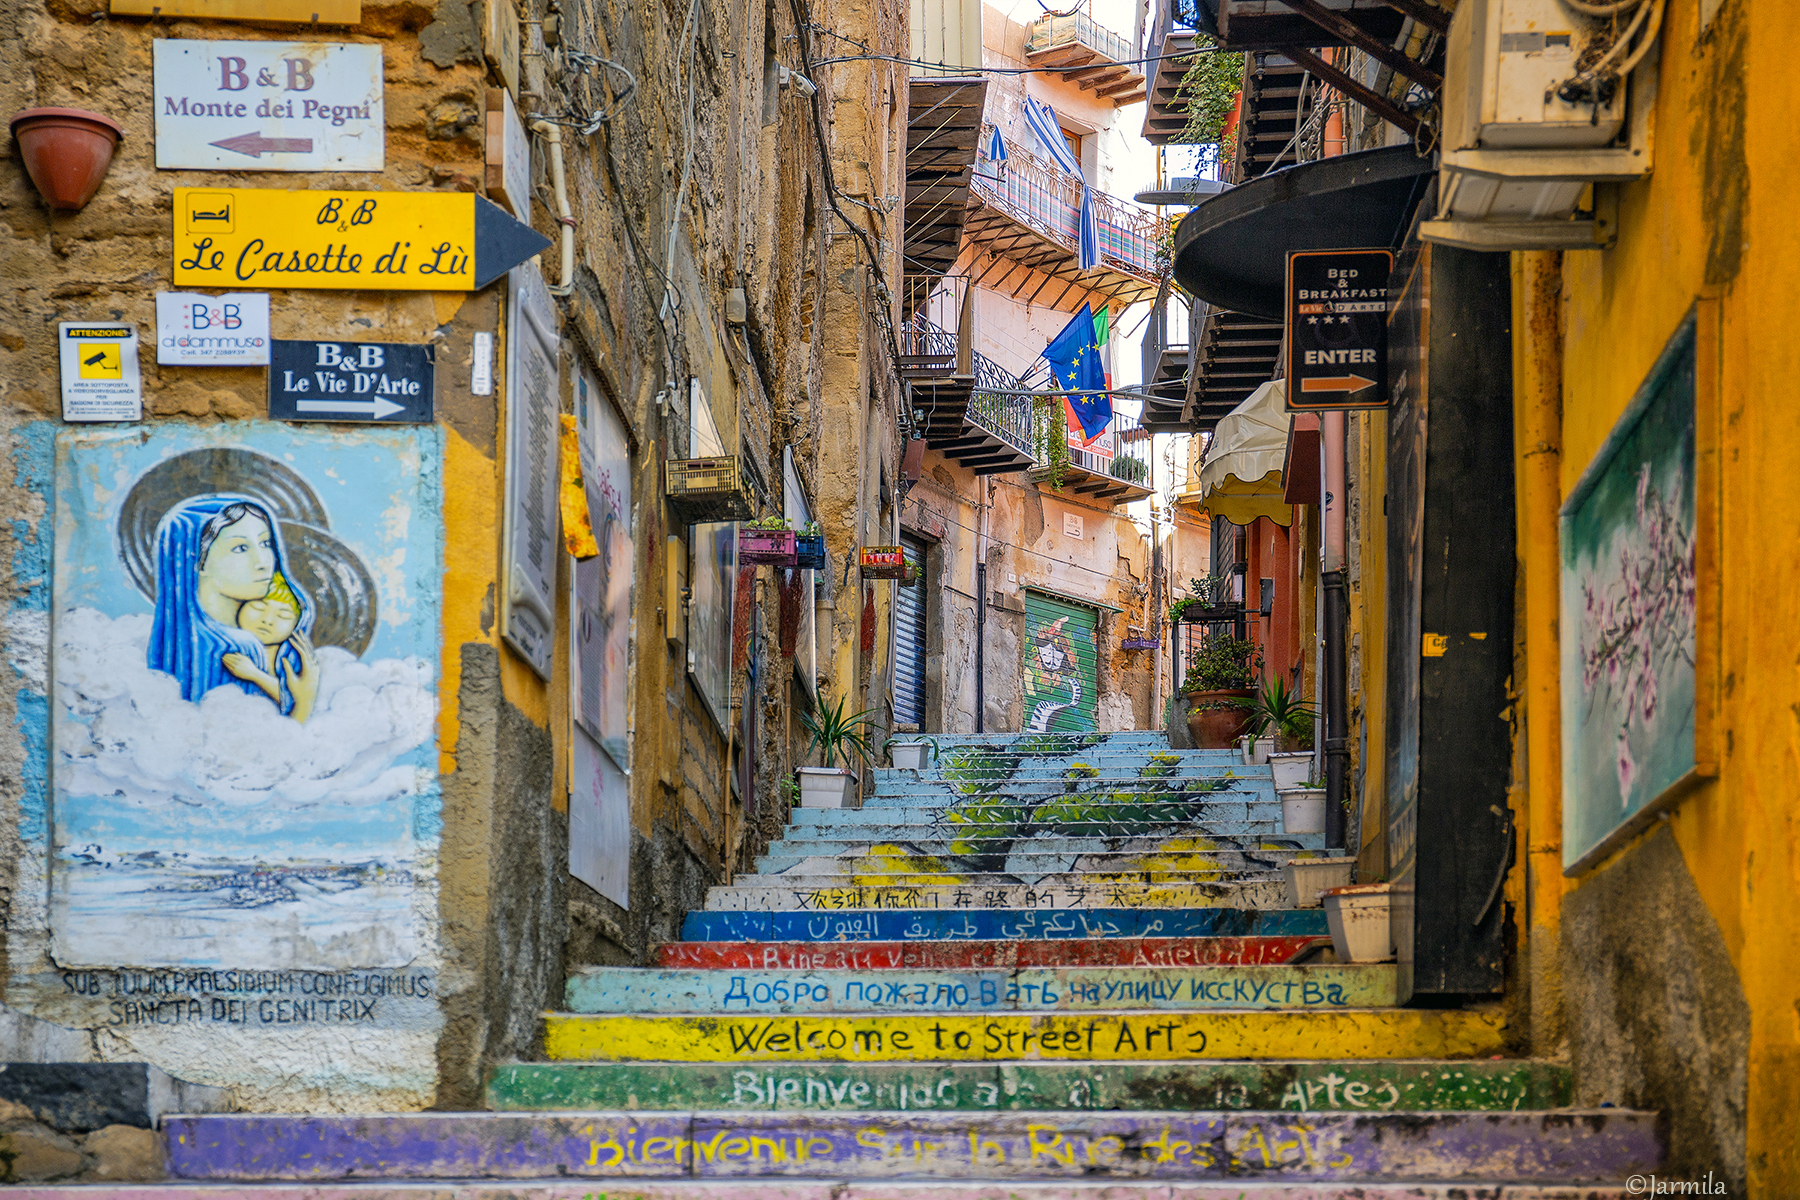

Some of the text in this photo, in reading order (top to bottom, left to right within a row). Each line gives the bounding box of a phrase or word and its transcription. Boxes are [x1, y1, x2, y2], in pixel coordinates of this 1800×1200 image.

[164, 96, 372, 126] Monte dei Pegni
[180, 237, 469, 281] Le Casette di Lù
[1338, 278, 1348, 288] &
[1304, 349, 1377, 365] ENTER
[283, 370, 421, 395] Le Vie D'Arte
[62, 971, 100, 996] SUB
[301, 972, 430, 998] CONFUGIMUS
[108, 998, 378, 1026] SANCTA DEI GENITRIX
[729, 1020, 914, 1054] Welcome
[928, 1021, 972, 1051] to
[983, 1022, 1101, 1053] Street
